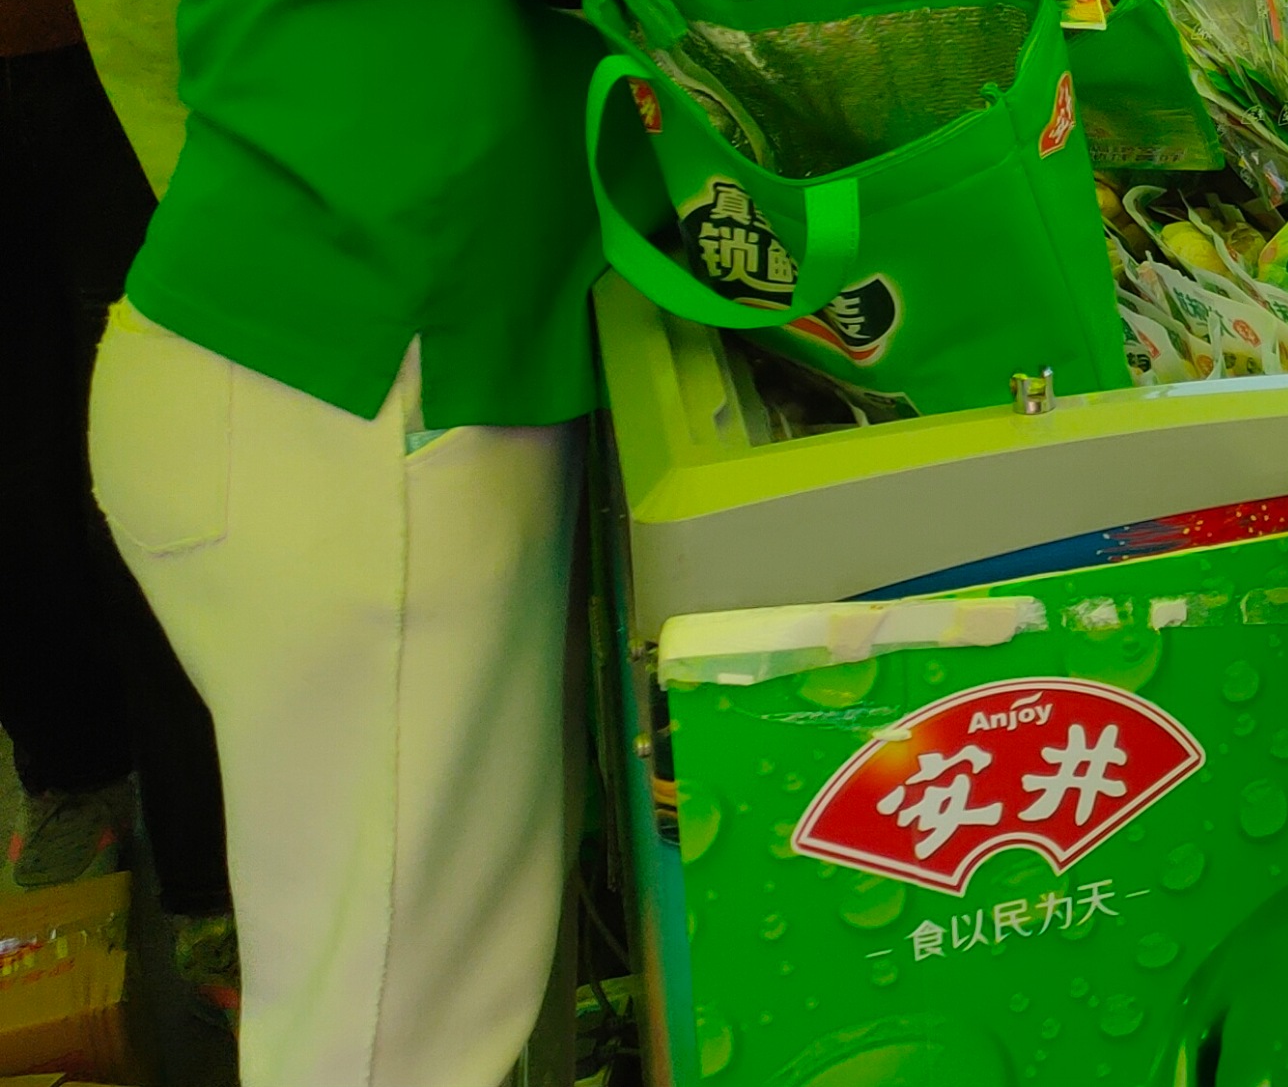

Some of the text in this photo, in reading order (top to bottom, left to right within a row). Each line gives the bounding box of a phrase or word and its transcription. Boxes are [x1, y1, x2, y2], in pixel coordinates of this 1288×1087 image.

[968, 692, 1053, 735] Anjoy
[876, 722, 1130, 861] 安井
[905, 879, 1119, 961] 食以民为天
